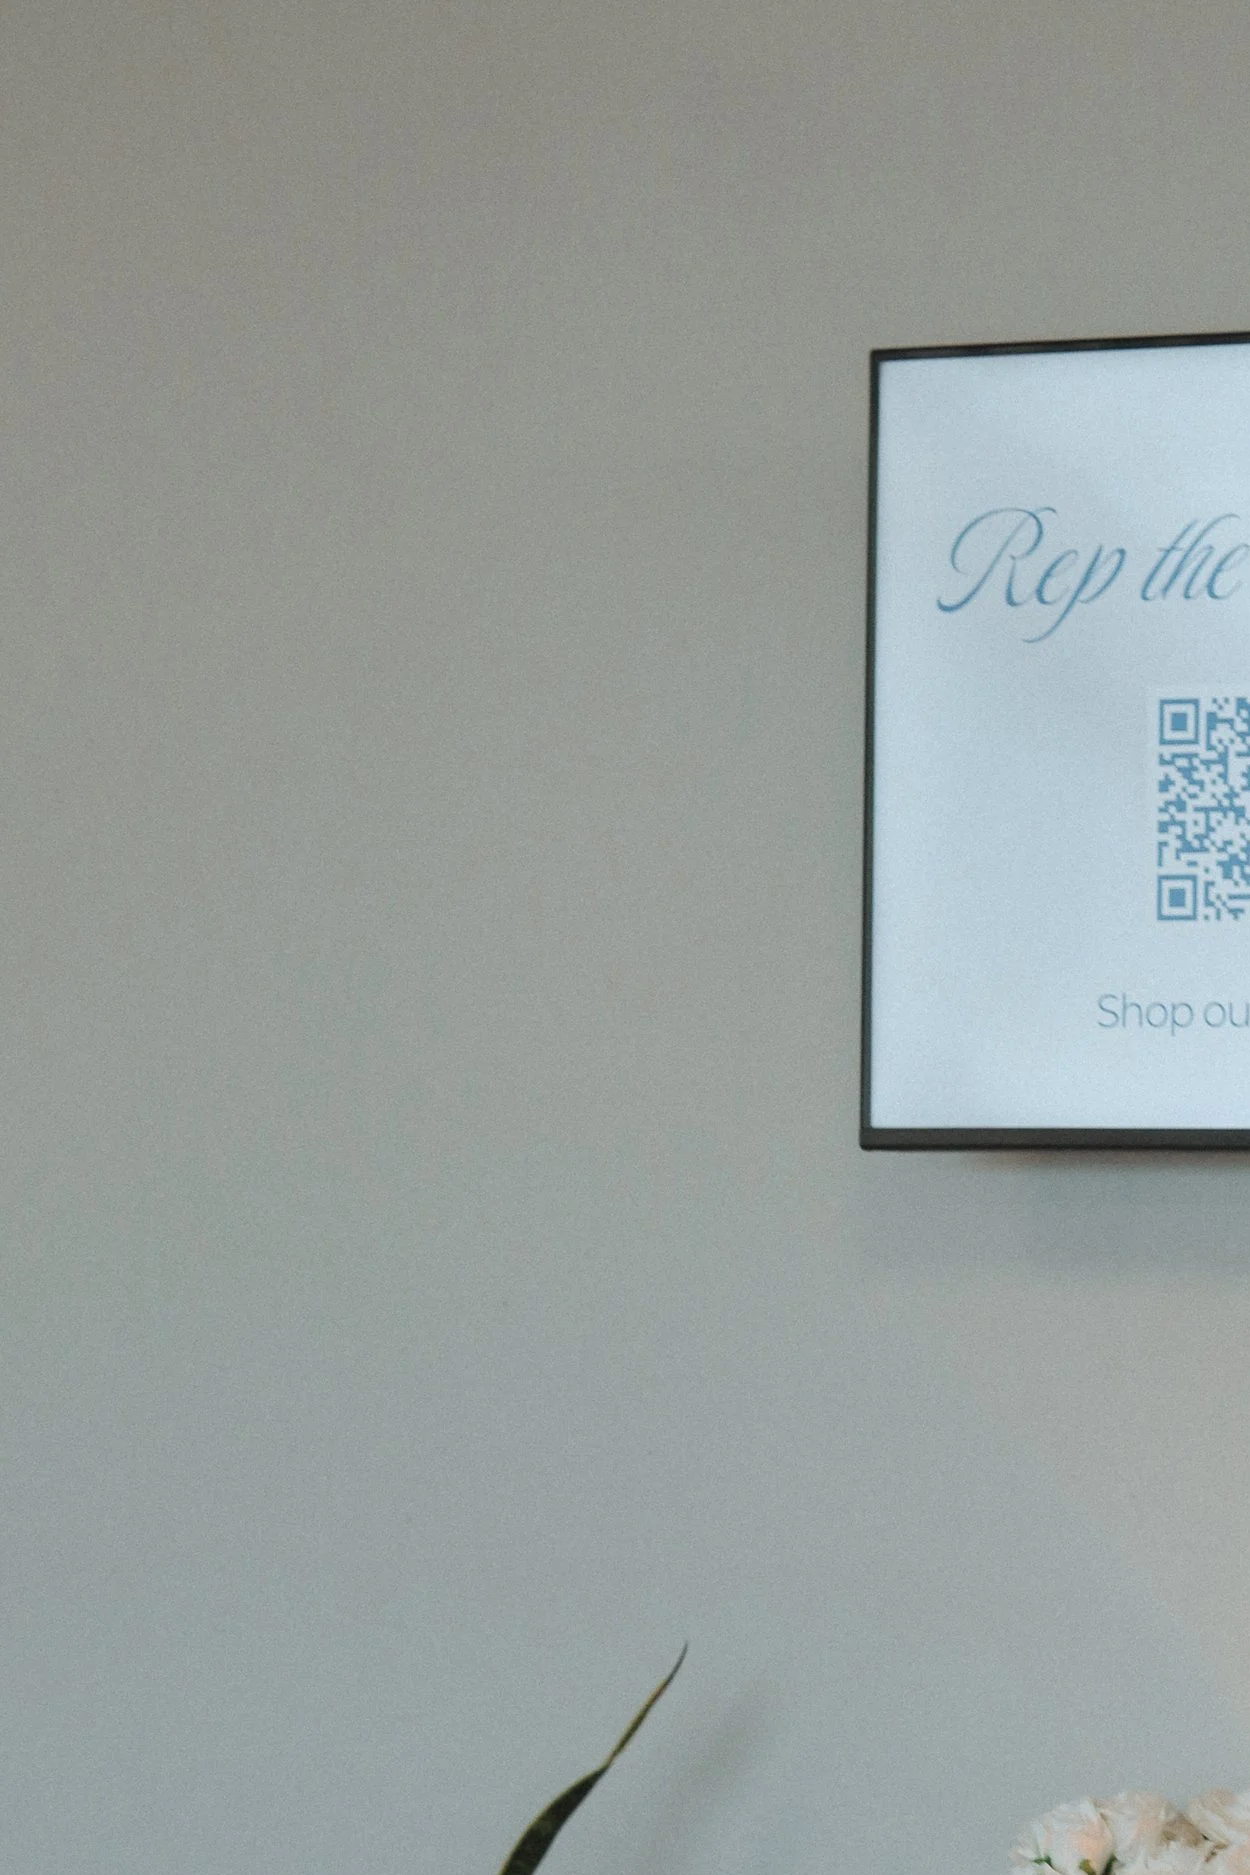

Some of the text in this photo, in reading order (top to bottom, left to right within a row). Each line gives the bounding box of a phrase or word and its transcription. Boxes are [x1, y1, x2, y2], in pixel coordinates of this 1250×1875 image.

[936, 506, 1127, 644] Rep
[1140, 512, 1250, 601] the
[1097, 992, 1195, 1037] Shop
